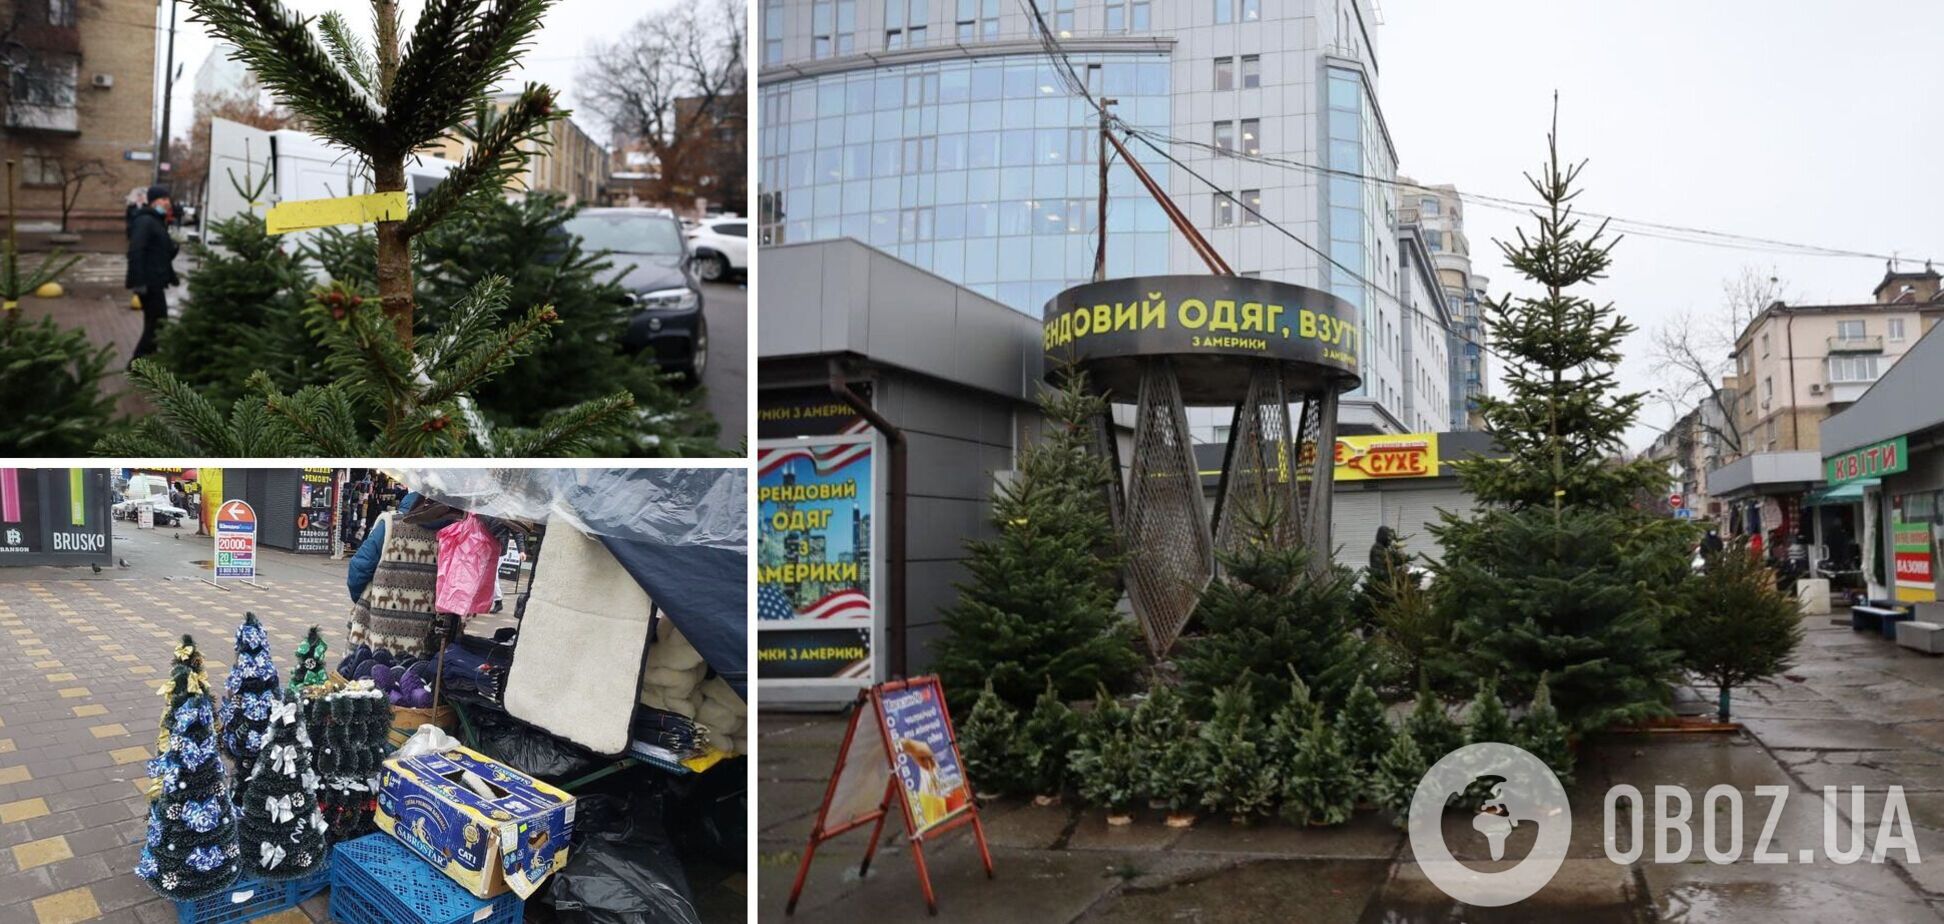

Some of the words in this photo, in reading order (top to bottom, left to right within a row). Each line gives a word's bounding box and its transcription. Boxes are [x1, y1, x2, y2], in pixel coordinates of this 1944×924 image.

[1178, 299, 1291, 338] ОДЯГ,
[1203, 338, 1266, 350] АМЕРИКИ
[1371, 452, 1420, 472] СУХЕ
[1835, 442, 1897, 481] КВІТИ
[758, 478, 856, 502] РЕНДОВИЙ
[772, 509, 832, 532] ОДЯГ
[53, 532, 105, 551] BRUSKO
[800, 648, 864, 660] АМЕРИКИ
[397, 825, 444, 866] SABROSTAR
[458, 848, 473, 861] CAT
